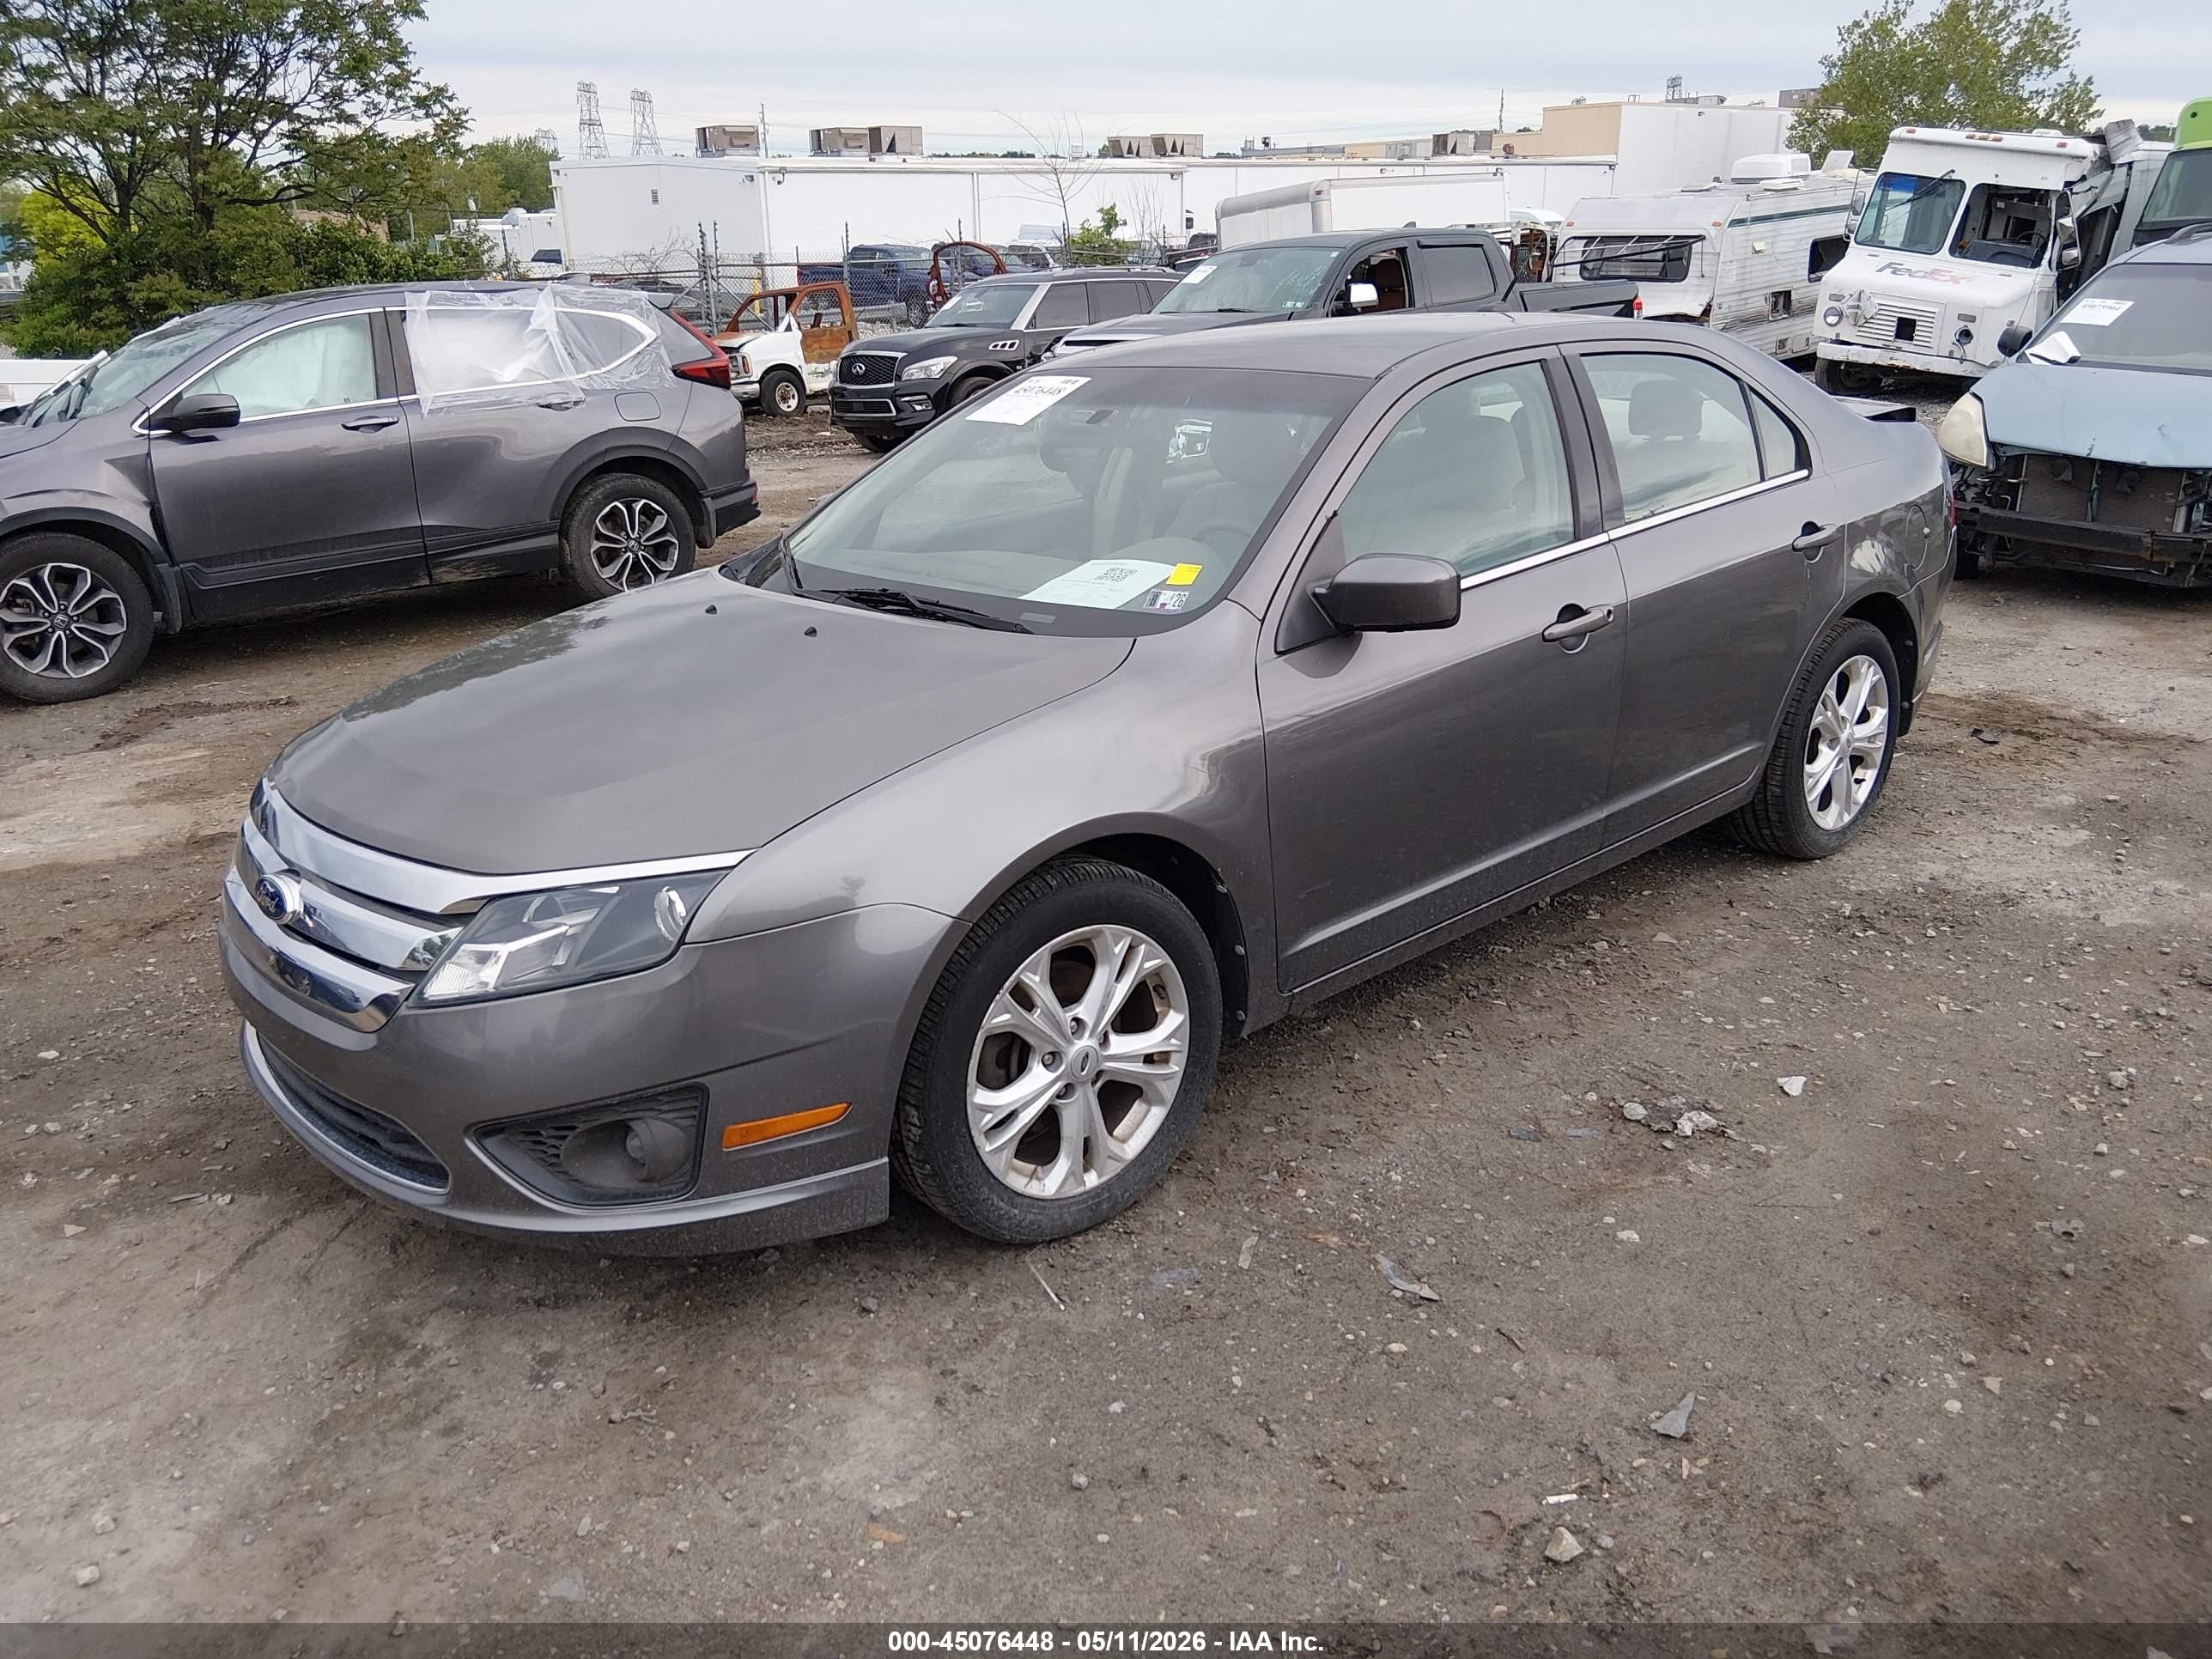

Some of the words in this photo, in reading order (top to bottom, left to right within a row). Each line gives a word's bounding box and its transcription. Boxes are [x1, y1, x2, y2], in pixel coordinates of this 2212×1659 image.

[1875, 262, 1966, 284] FedEx
[1171, 592, 1187, 608] 26
[256, 881, 278, 914] Ford
